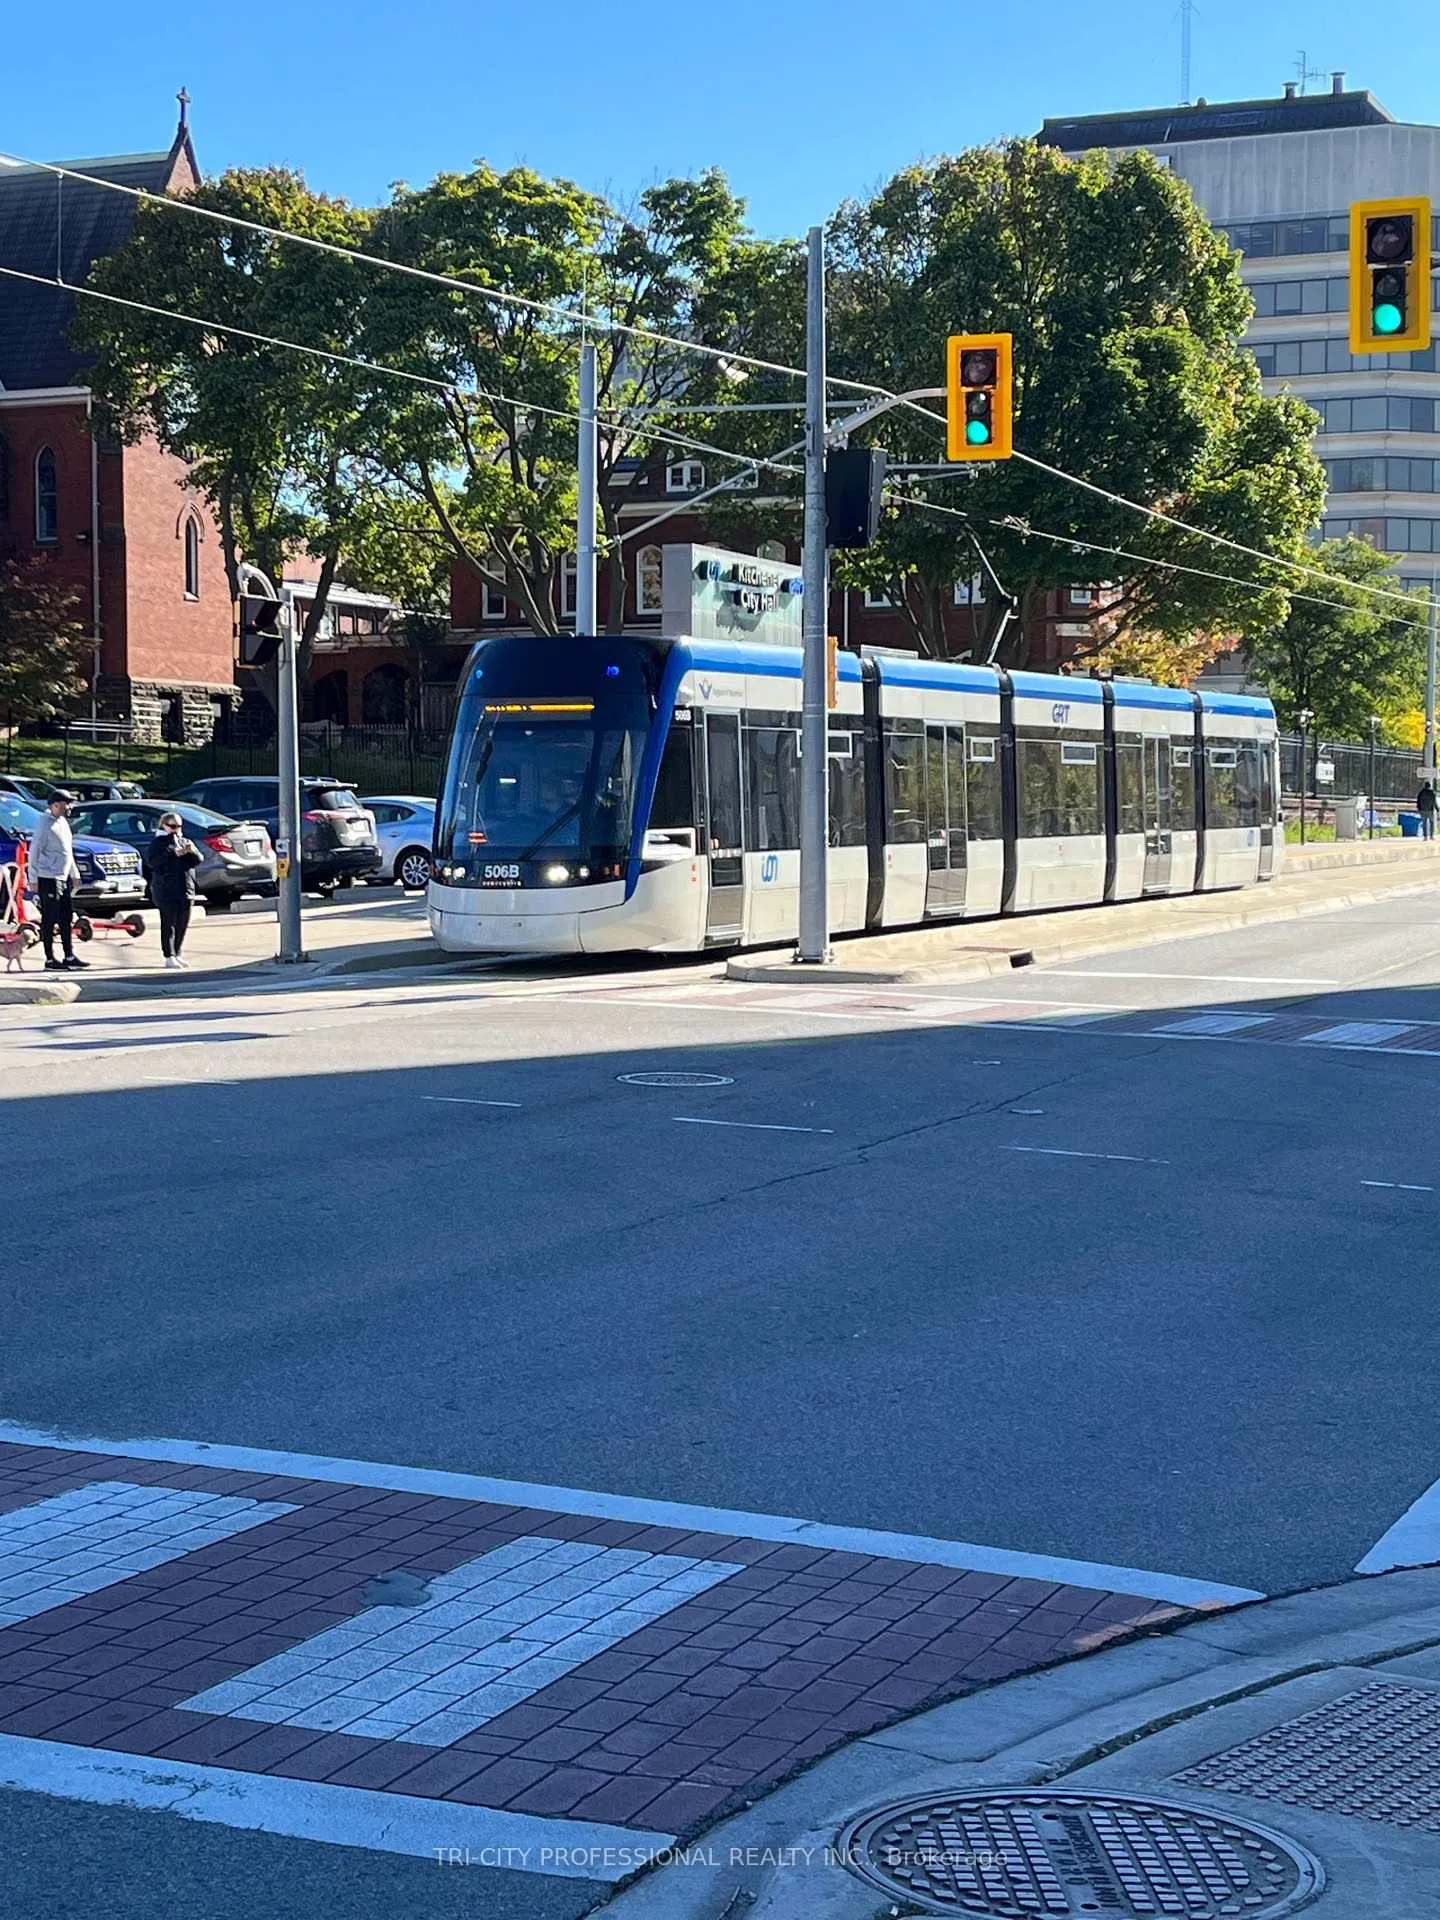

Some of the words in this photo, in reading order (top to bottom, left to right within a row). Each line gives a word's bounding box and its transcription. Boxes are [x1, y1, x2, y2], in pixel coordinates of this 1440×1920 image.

[741, 588, 760, 616] City
[761, 592, 781, 612] Hall
[1052, 703, 1070, 724] GRT
[484, 864, 520, 878] 506B
